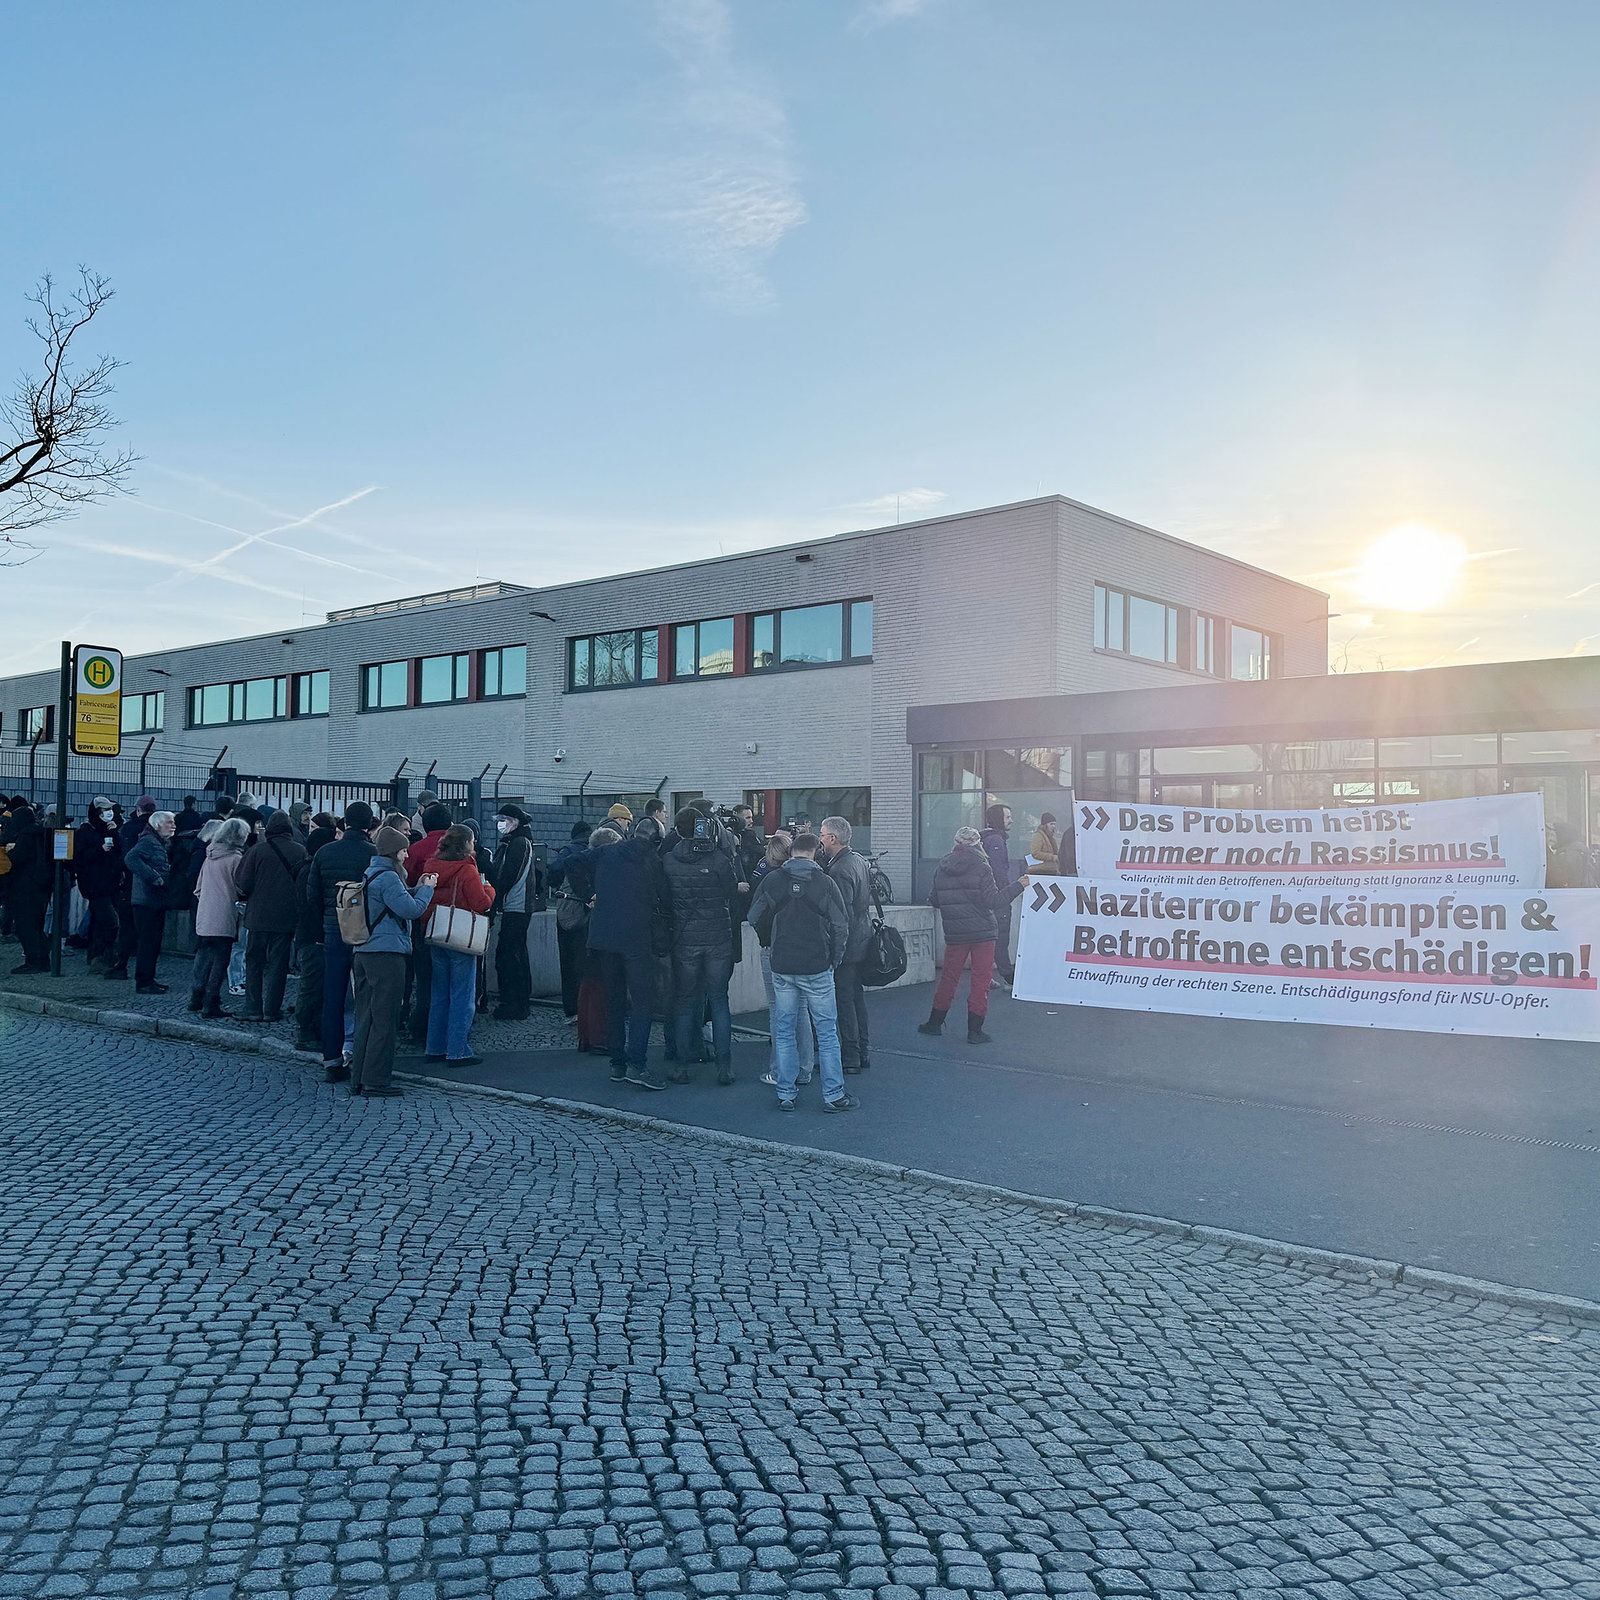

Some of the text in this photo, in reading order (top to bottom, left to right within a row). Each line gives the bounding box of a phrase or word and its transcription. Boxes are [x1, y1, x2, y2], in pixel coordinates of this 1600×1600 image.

[93, 663, 106, 682] H
[81, 713, 92, 722] 76
[1118, 807, 1412, 834] Das Problem heißt
[1119, 835, 1501, 866] immer noch Rassismus!
[1176, 875, 1192, 885] mit
[1196, 875, 1217, 885] den
[1219, 875, 1286, 887] Betroffenen.
[1288, 876, 1360, 888] Aufarbeitung
[1364, 875, 1389, 886] statt
[1391, 875, 1442, 887] Ignoranz
[1444, 874, 1454, 884] &
[1457, 873, 1520, 886] Leugnung.
[1075, 885, 1559, 938] Naziterror bekämpfen &
[1072, 925, 1592, 986] Betroffene entschädigen!
[1068, 968, 1550, 1010] Entwaffnung der rechten Szene. Entschädigungsfond für NSU-Opfer.
